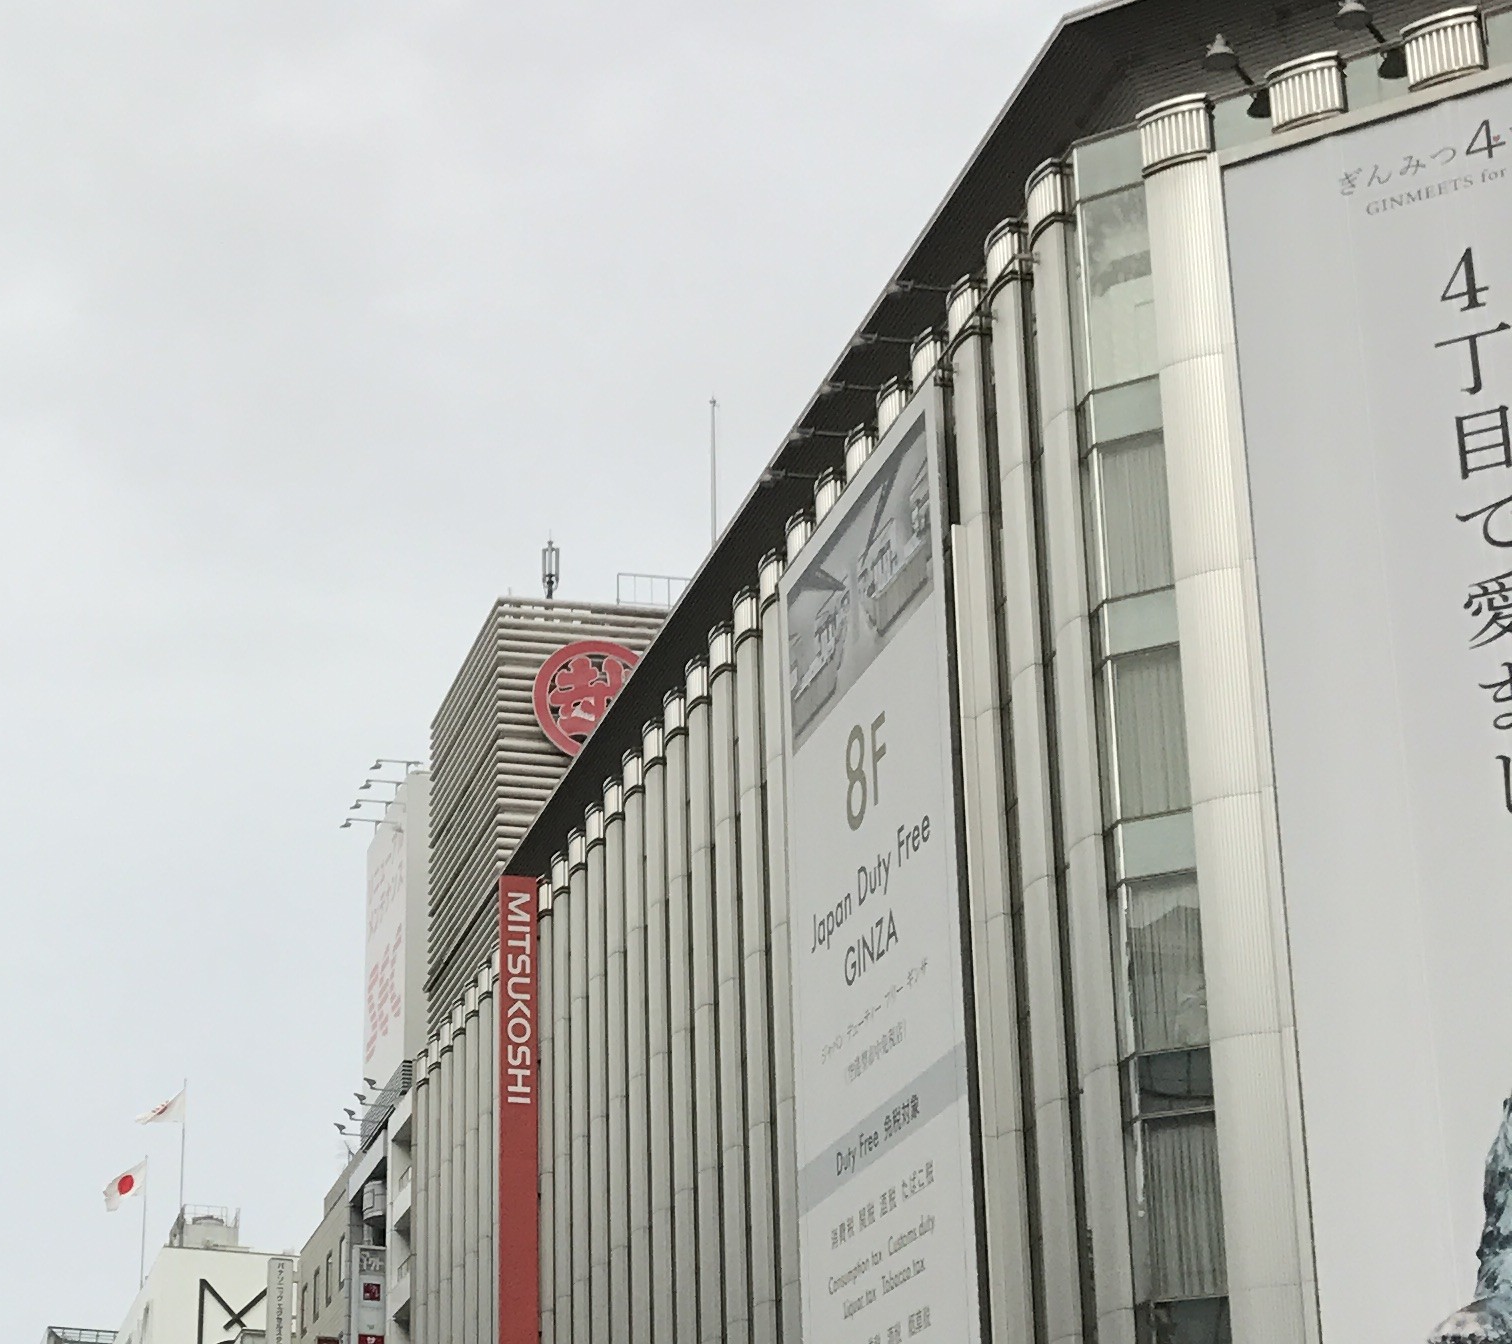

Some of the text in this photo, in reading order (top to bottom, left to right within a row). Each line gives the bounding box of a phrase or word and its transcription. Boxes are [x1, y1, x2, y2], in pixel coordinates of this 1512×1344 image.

[1365, 174, 1474, 216] GINMEETS
[845, 709, 888, 832] 8F
[811, 814, 931, 954] Japan Duty Free
[843, 907, 899, 987] GINZA
[506, 890, 532, 1106] MITSUKOSHI
[836, 1146, 857, 1177] Duty
[859, 1130, 880, 1158] Free
